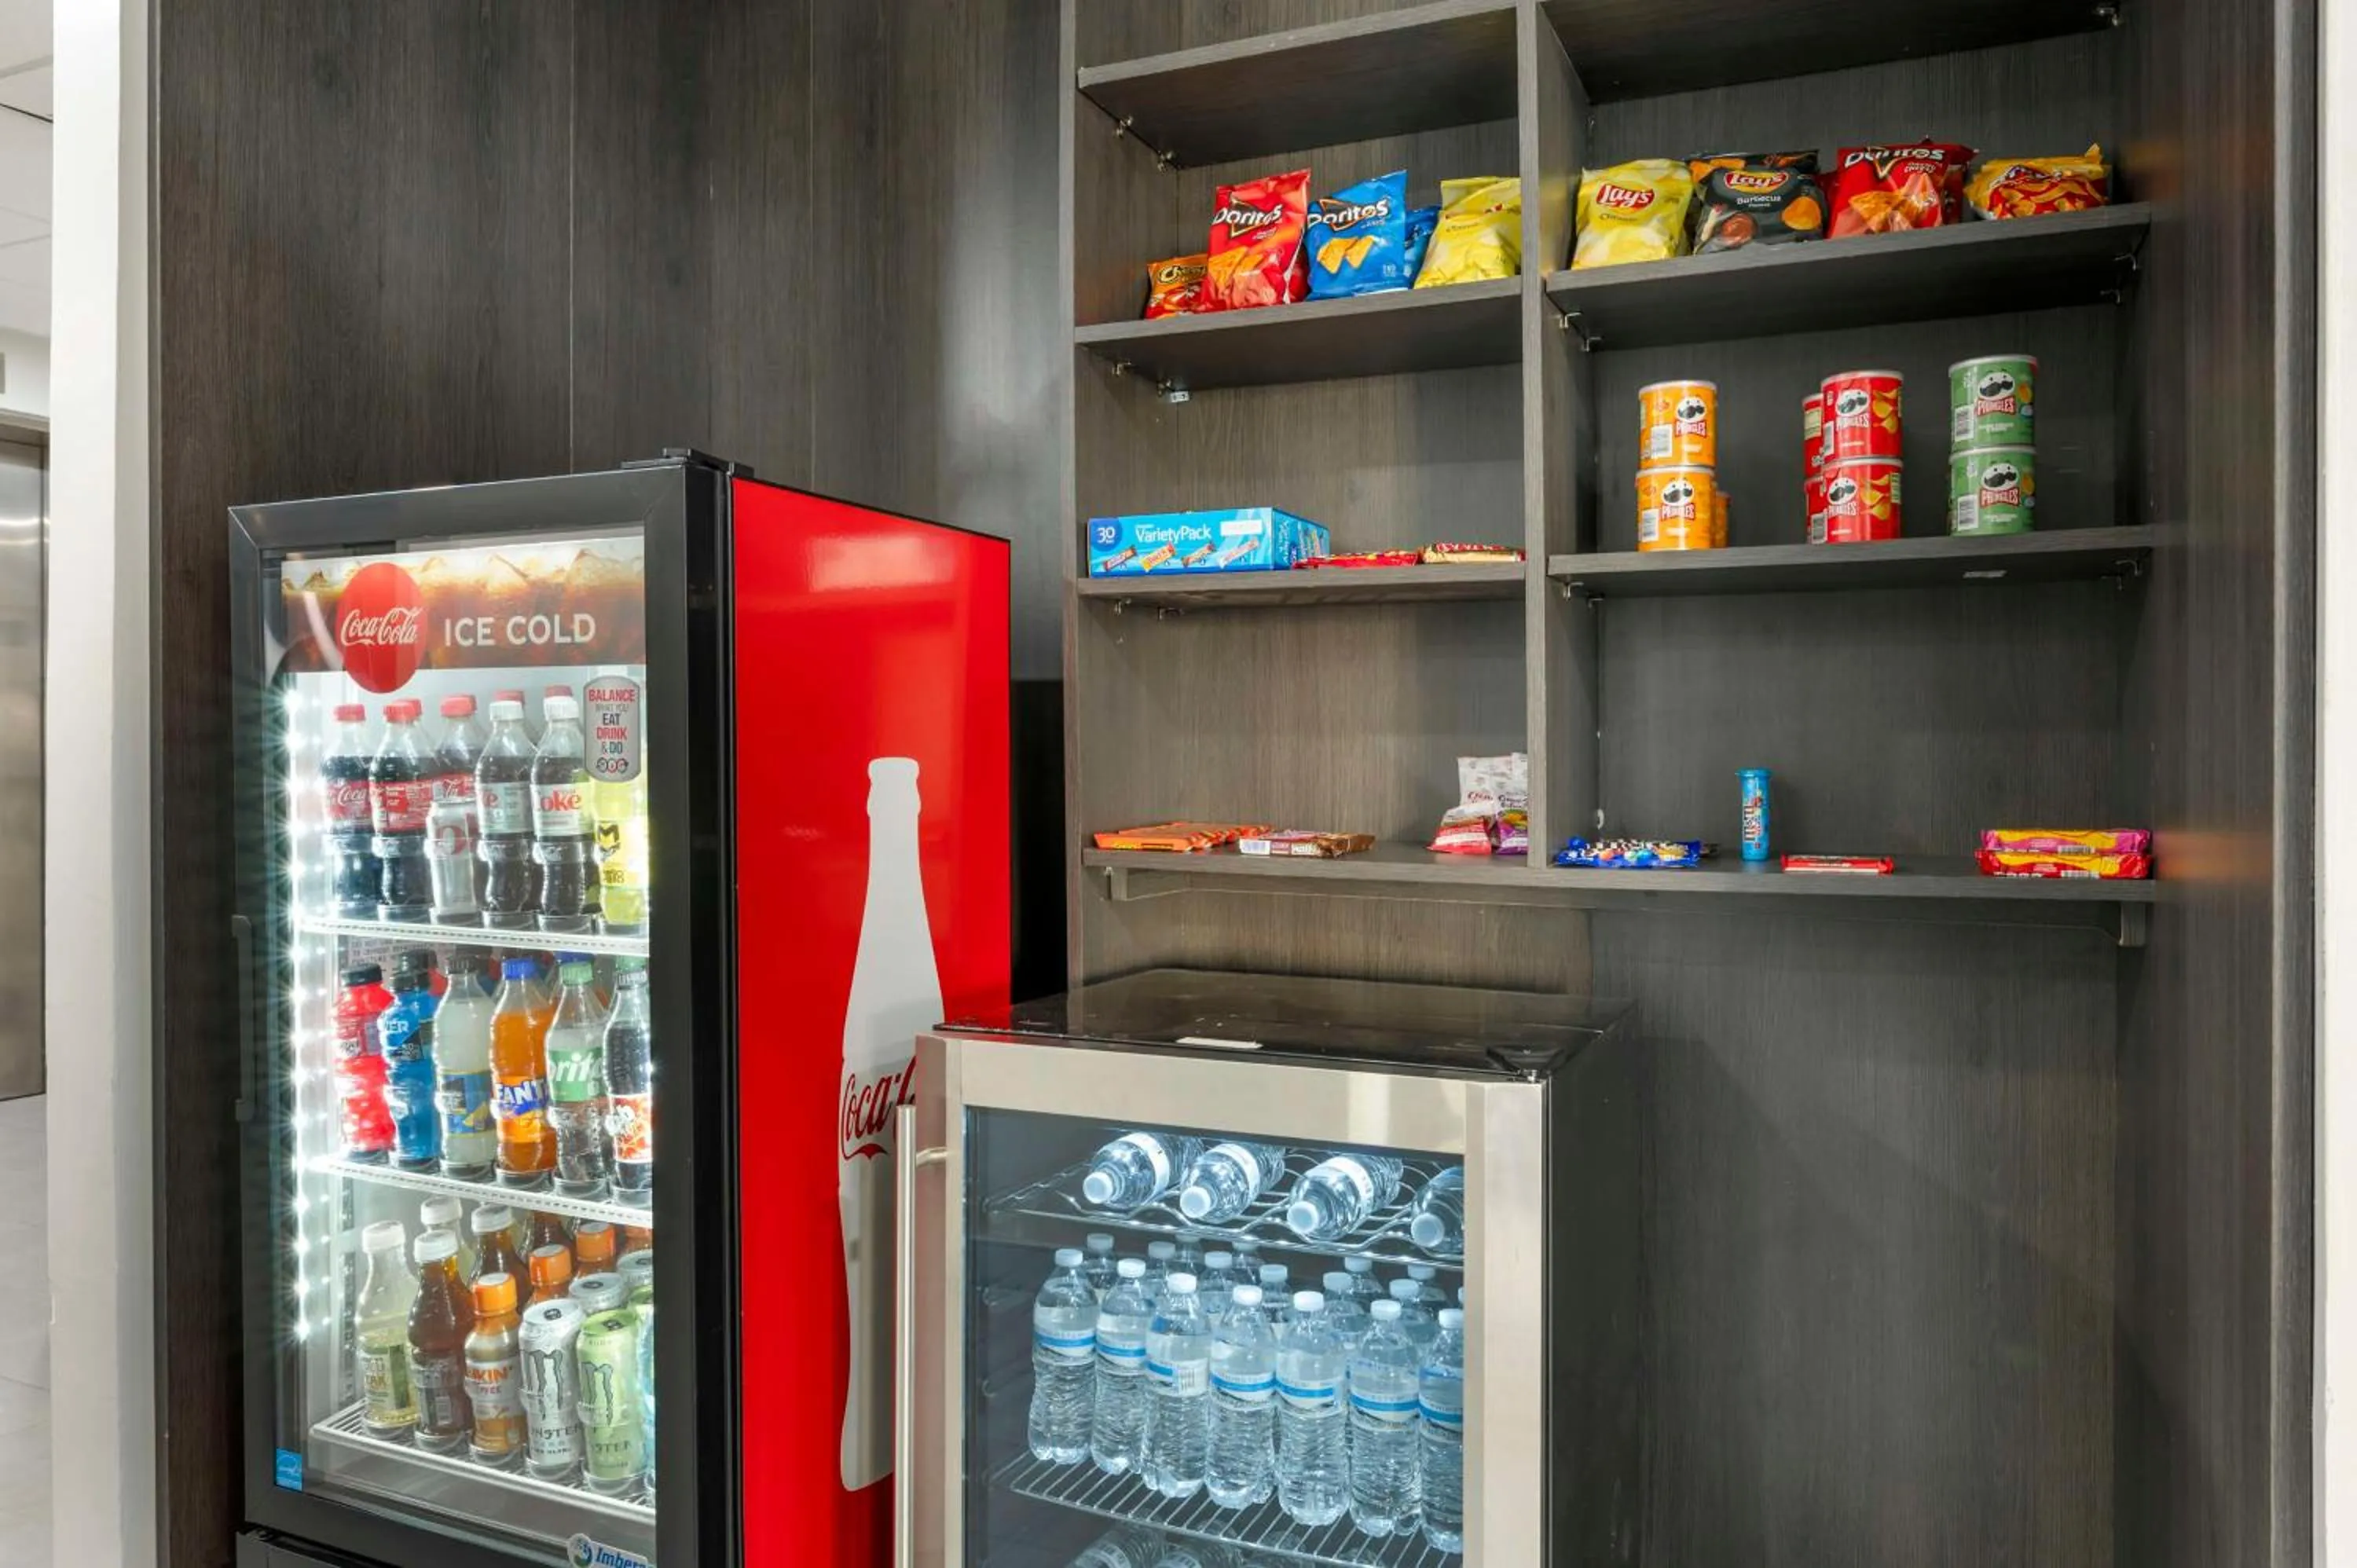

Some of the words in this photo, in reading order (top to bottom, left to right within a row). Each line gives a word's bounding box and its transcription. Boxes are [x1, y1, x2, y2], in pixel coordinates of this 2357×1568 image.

[1599, 184, 1653, 207] Lay's
[1211, 203, 1284, 225] Doritos
[1307, 198, 1389, 229] Doritos
[1097, 526, 1116, 543] 30
[1135, 527, 1180, 544] Variety
[1181, 524, 1212, 540] Pack
[341, 606, 423, 646] Coca-Cola
[445, 617, 495, 647] ICE
[507, 613, 596, 644] COLD
[588, 689, 635, 702] BALANCE
[603, 713, 621, 725] EAT
[596, 727, 627, 740] DRINK
[609, 742, 623, 754] DO
[541, 789, 582, 811] oke
[495, 1079, 547, 1105] FANT
